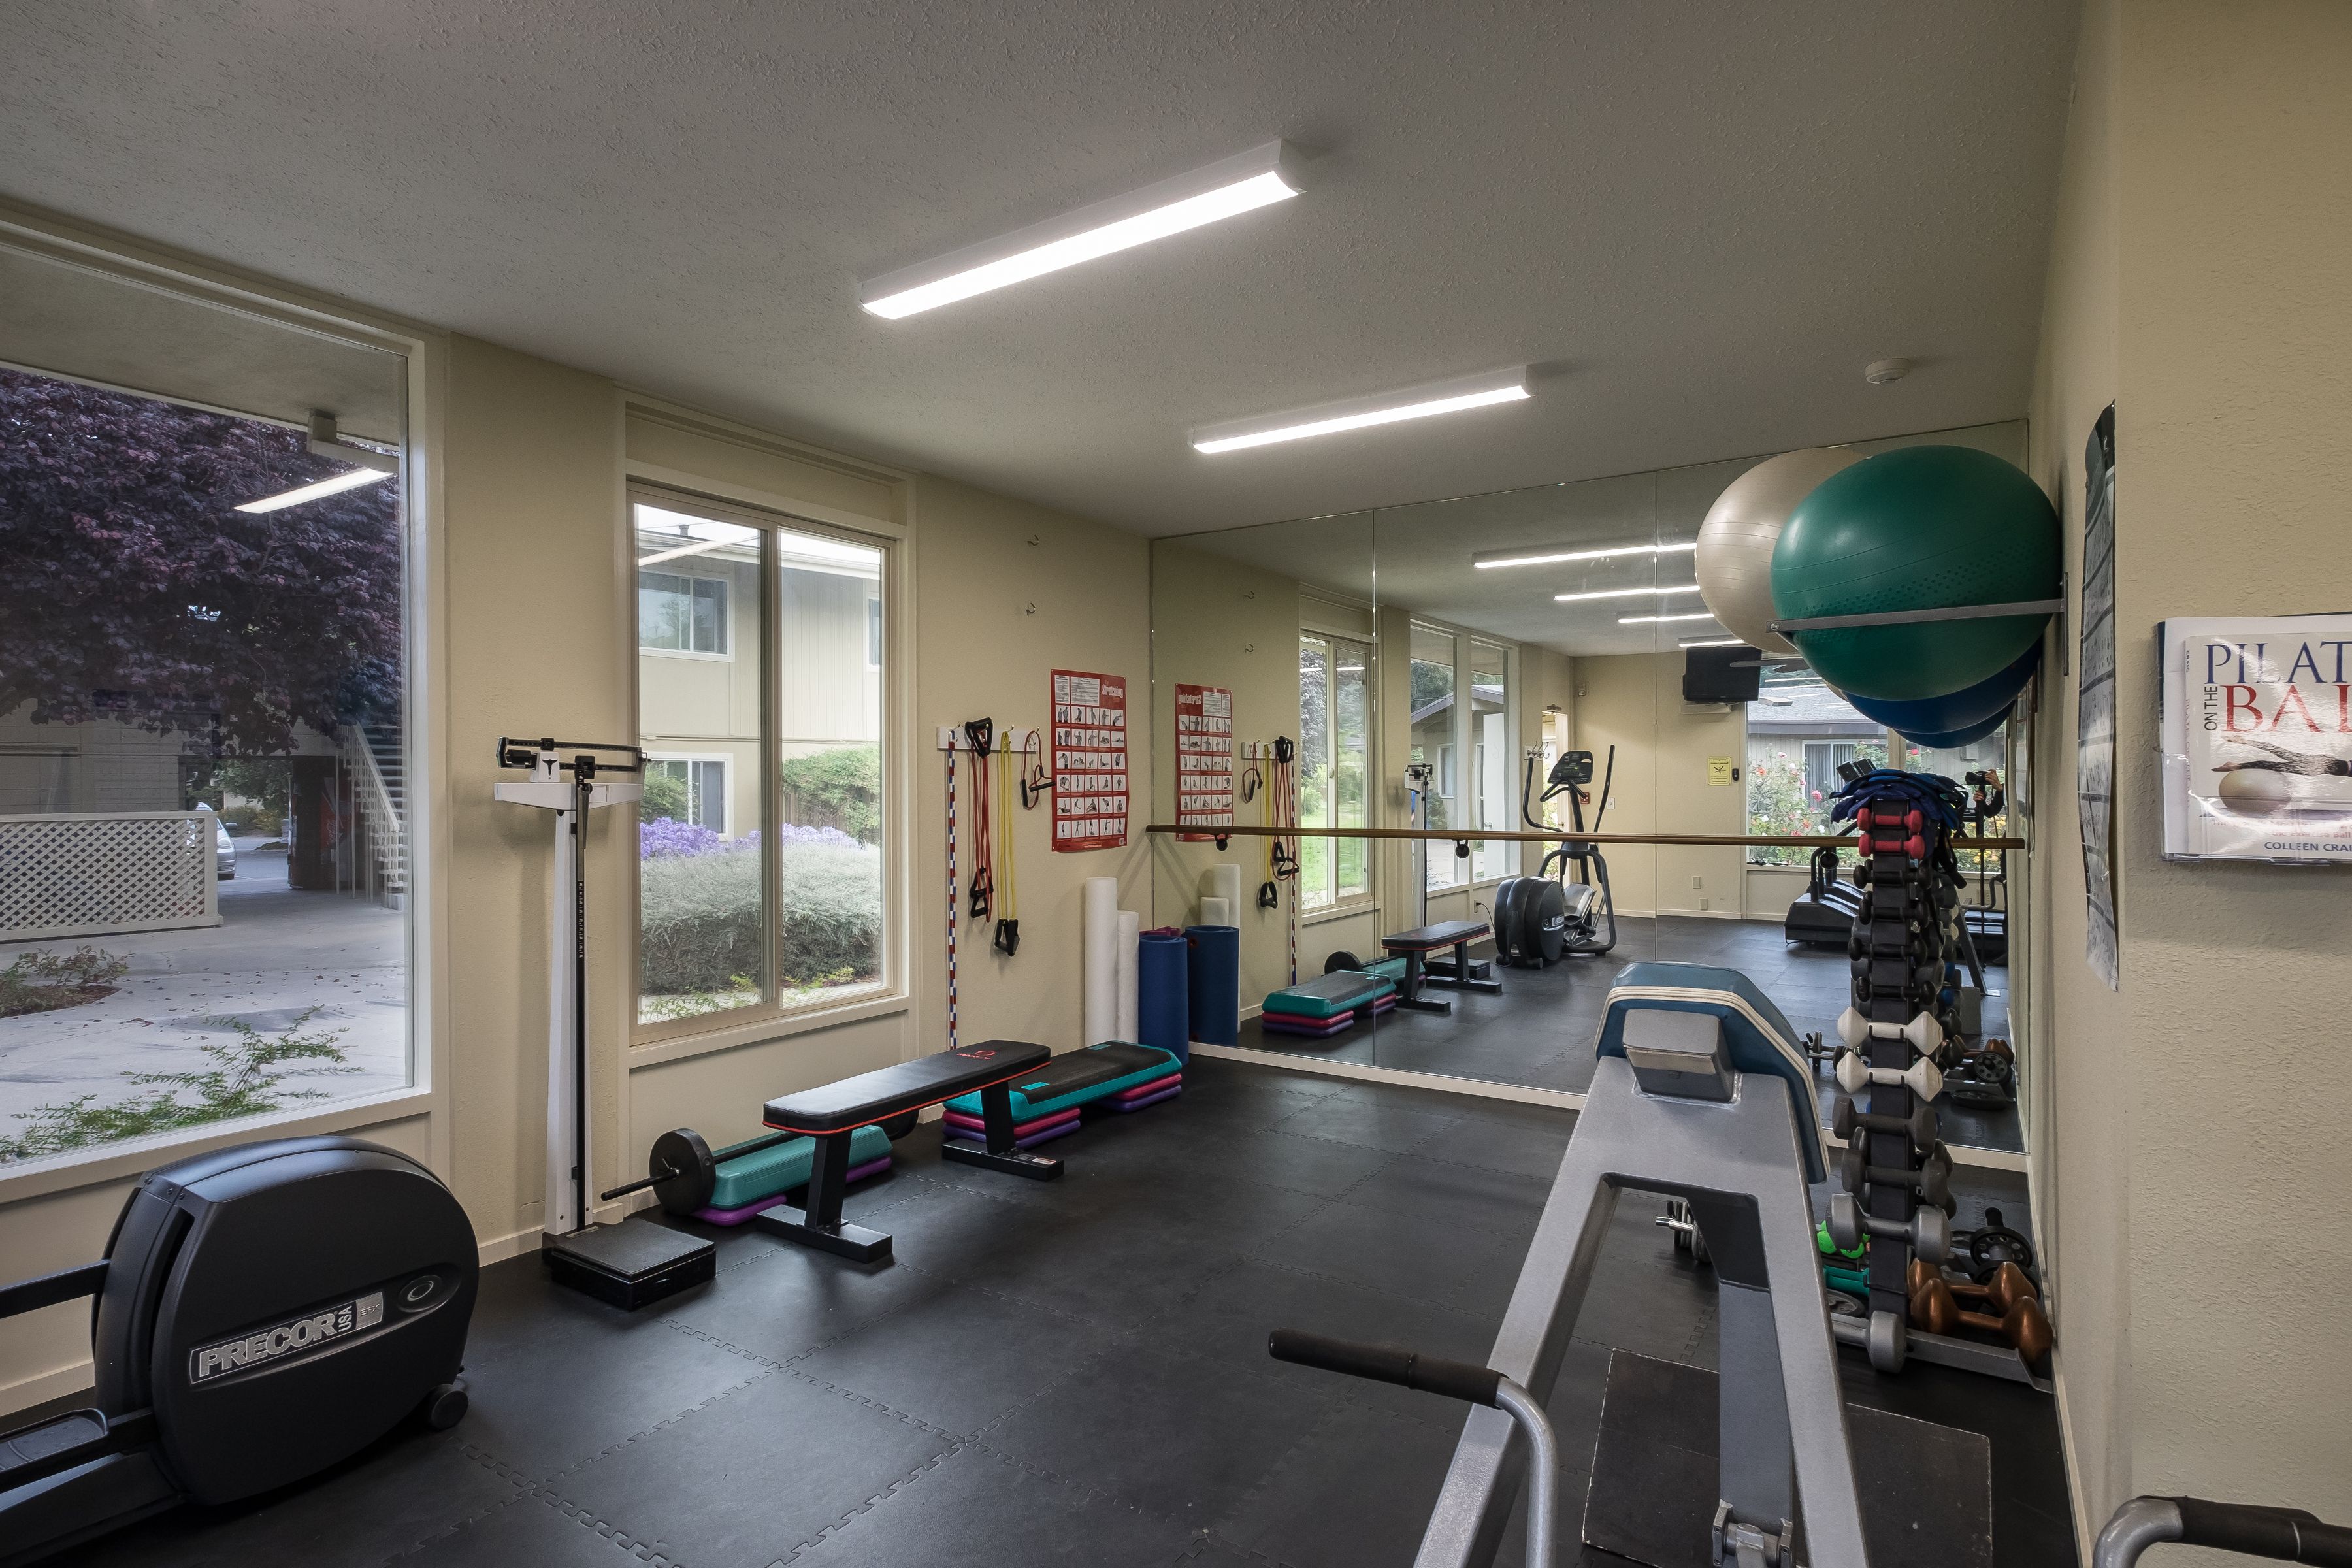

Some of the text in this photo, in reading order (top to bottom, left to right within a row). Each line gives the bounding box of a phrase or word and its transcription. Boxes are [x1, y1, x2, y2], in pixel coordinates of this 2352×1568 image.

[2204, 686, 2218, 731] ON THE
[2264, 841, 2319, 851] COLLEEN
[199, 1305, 352, 1377] PRECOR USA
